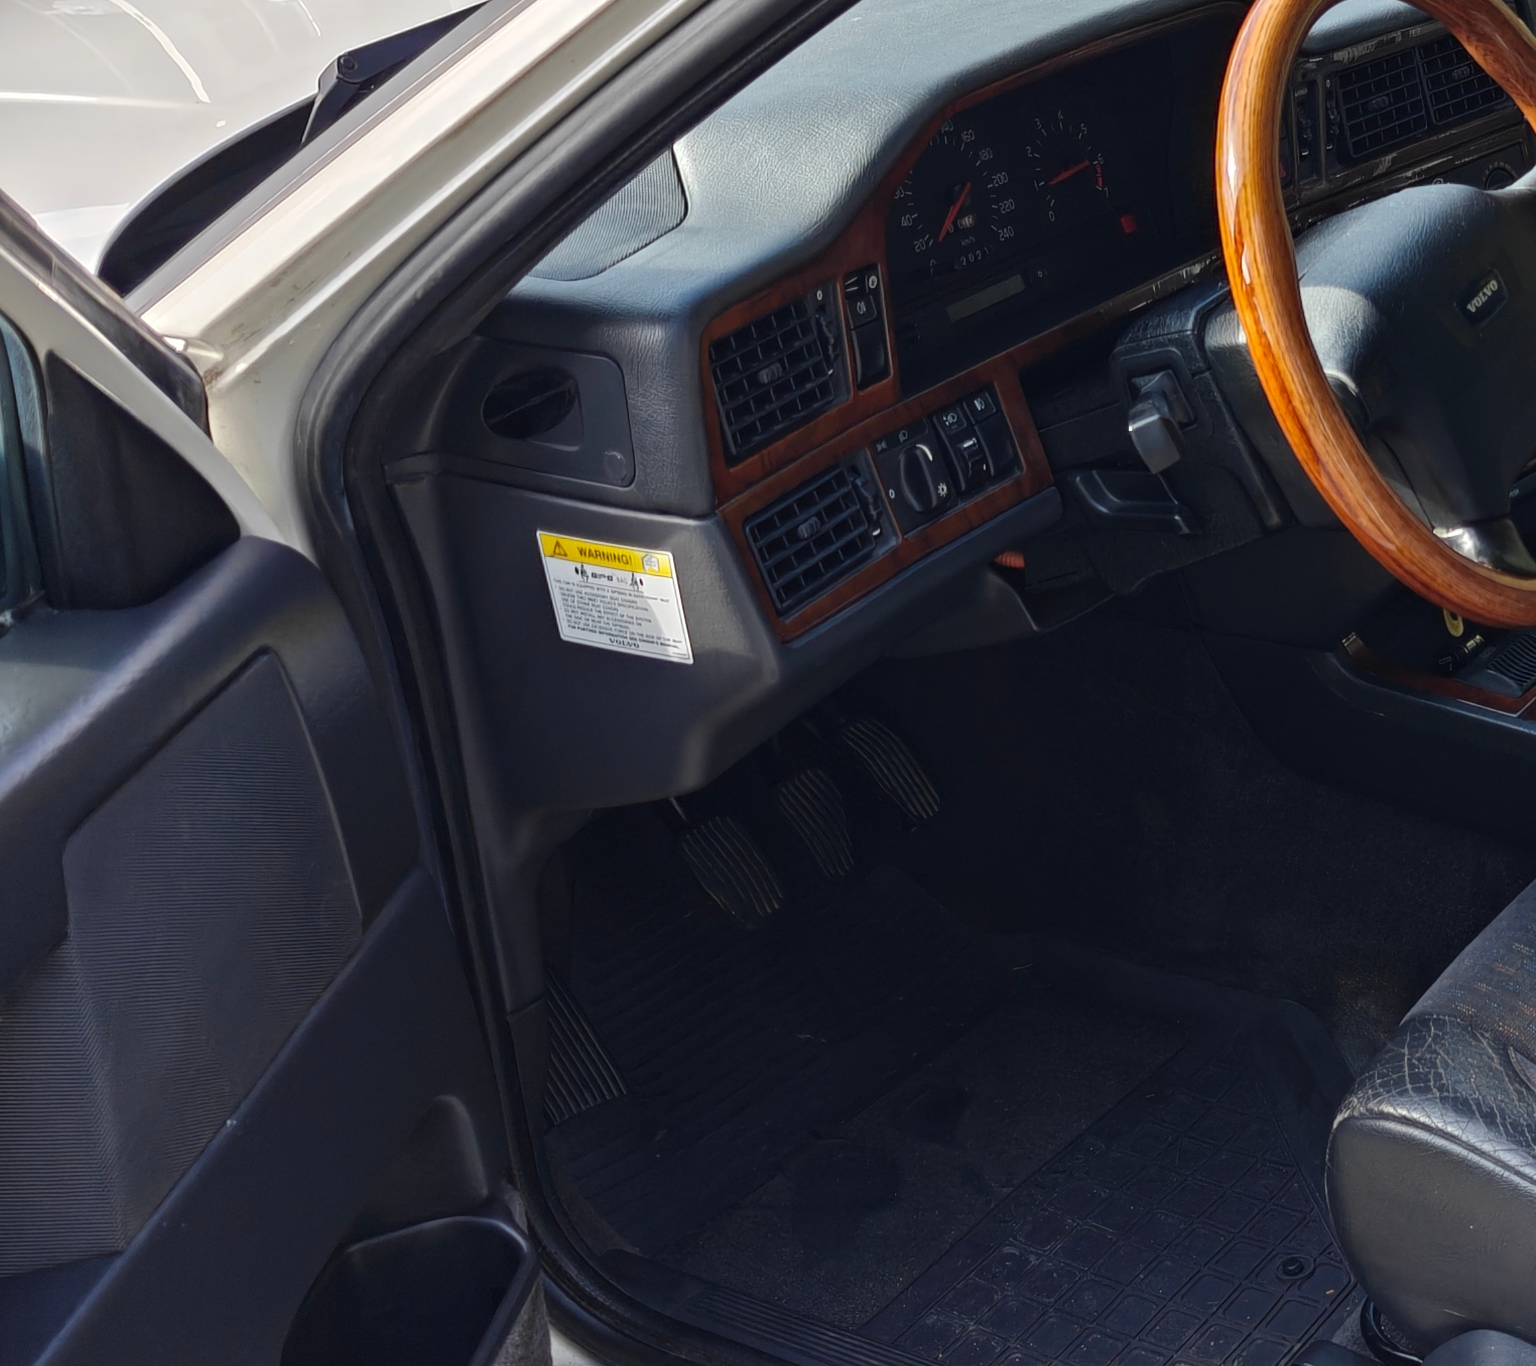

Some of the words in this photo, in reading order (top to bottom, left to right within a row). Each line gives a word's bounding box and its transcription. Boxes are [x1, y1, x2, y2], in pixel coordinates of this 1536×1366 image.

[1025, 146, 1033, 158] 2
[991, 171, 1009, 188] 200
[998, 198, 1016, 214] 220
[901, 214, 913, 227] 40
[998, 225, 1015, 241] 240
[913, 239, 926, 253] 20
[1466, 279, 1499, 313] VOLVO
[577, 546, 633, 566] WARNING!
[609, 637, 640, 649] VOLVO
